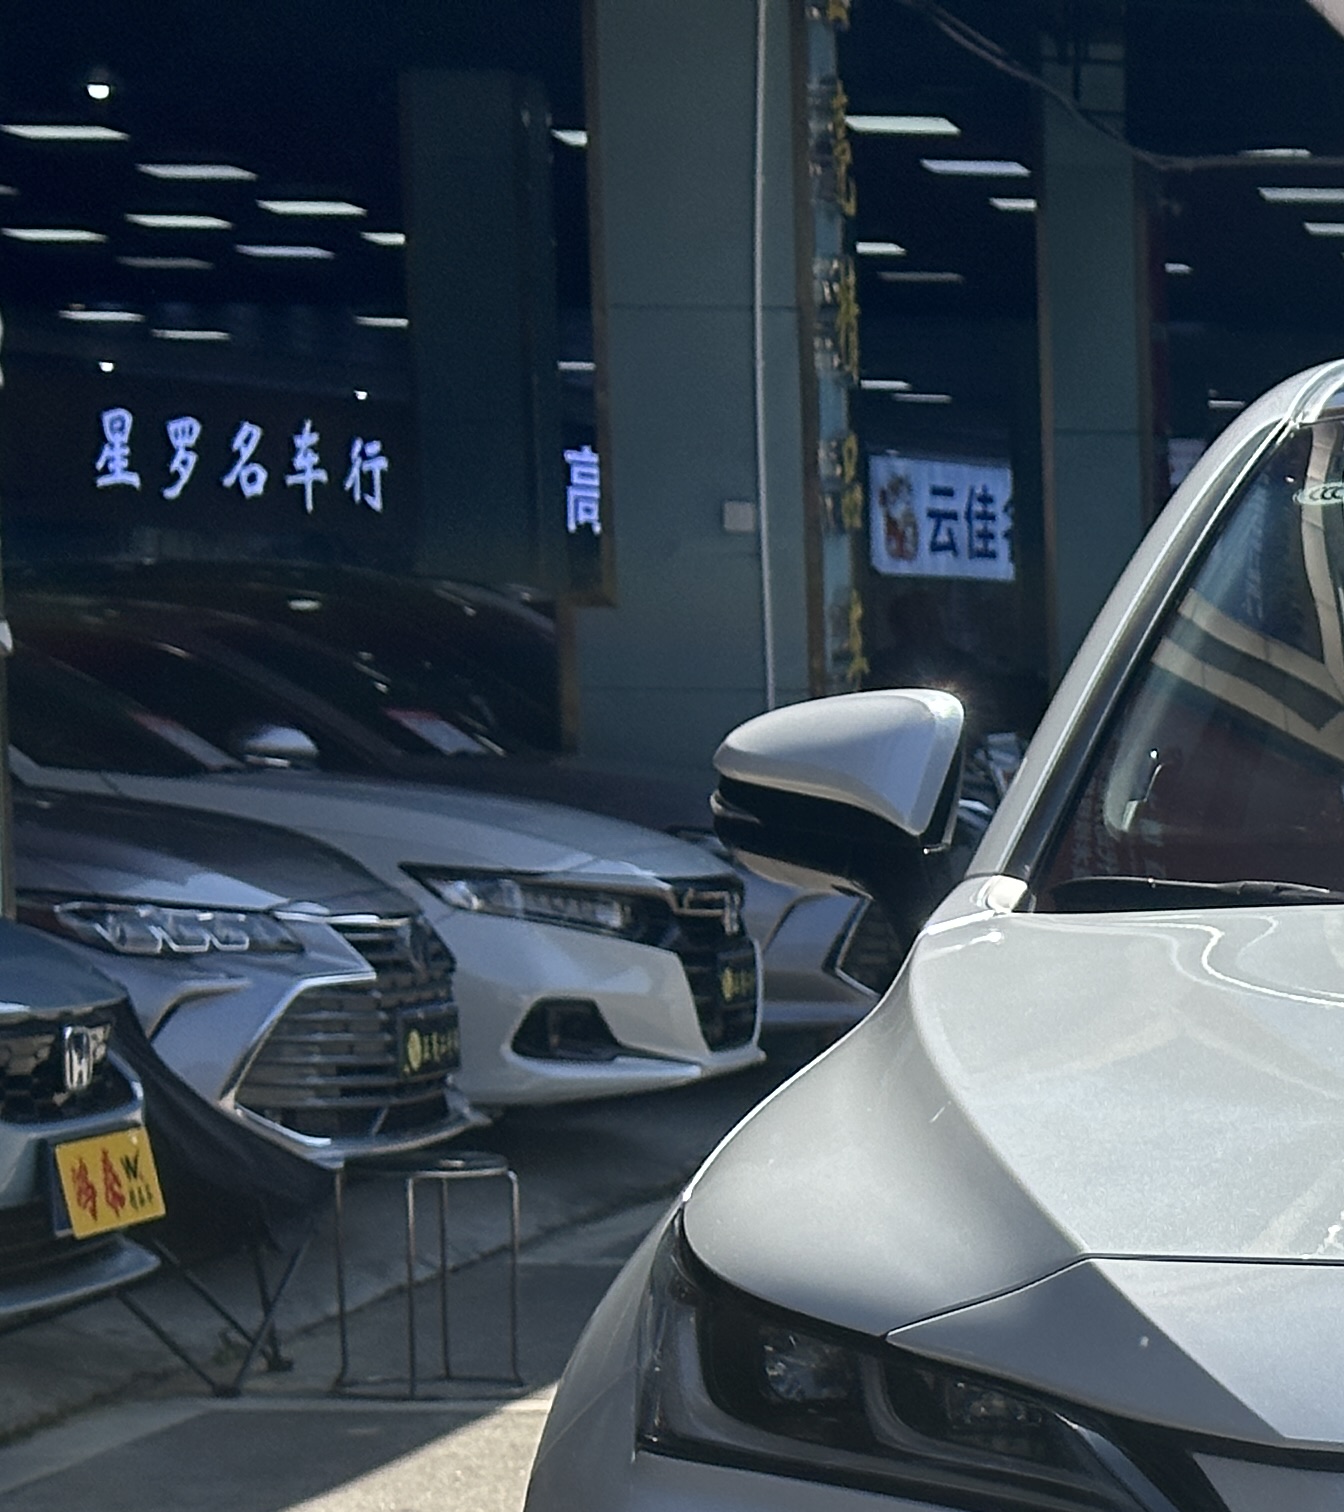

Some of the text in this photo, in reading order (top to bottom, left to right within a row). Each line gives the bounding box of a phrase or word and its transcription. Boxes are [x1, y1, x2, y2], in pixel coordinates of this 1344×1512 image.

[96, 407, 390, 514] 星罗名车行
[563, 445, 600, 535] 高
[926, 484, 1013, 561] 云佳
